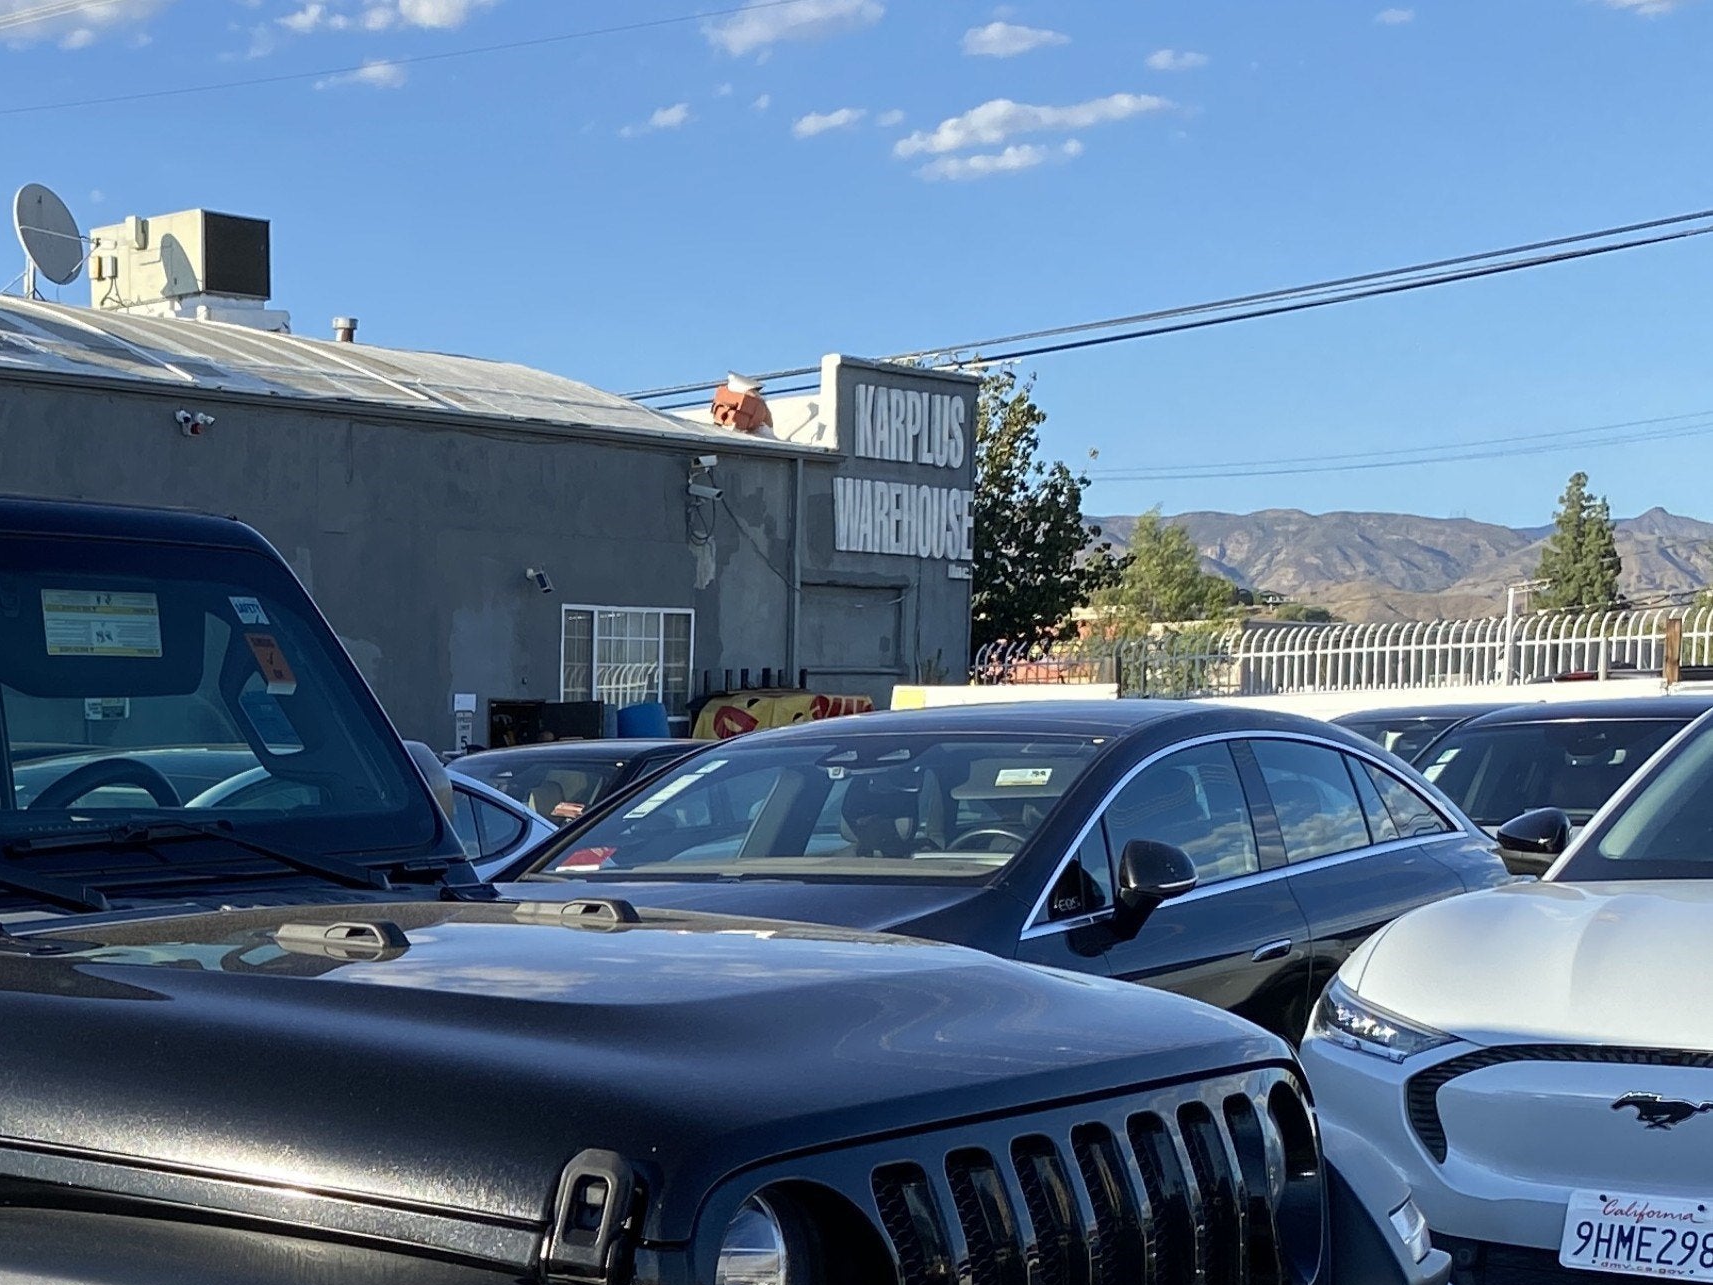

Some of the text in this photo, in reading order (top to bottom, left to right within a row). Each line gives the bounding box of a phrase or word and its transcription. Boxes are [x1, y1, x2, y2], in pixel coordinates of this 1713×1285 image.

[855, 383, 965, 469] KARPLUS
[833, 477, 974, 561] WAREHOUSE
[461, 736, 468, 750] 5
[1602, 1199, 1705, 1224] California
[1572, 1221, 1713, 1269] 9HME298
[1600, 1261, 1685, 1276] dmv.ca.gov
